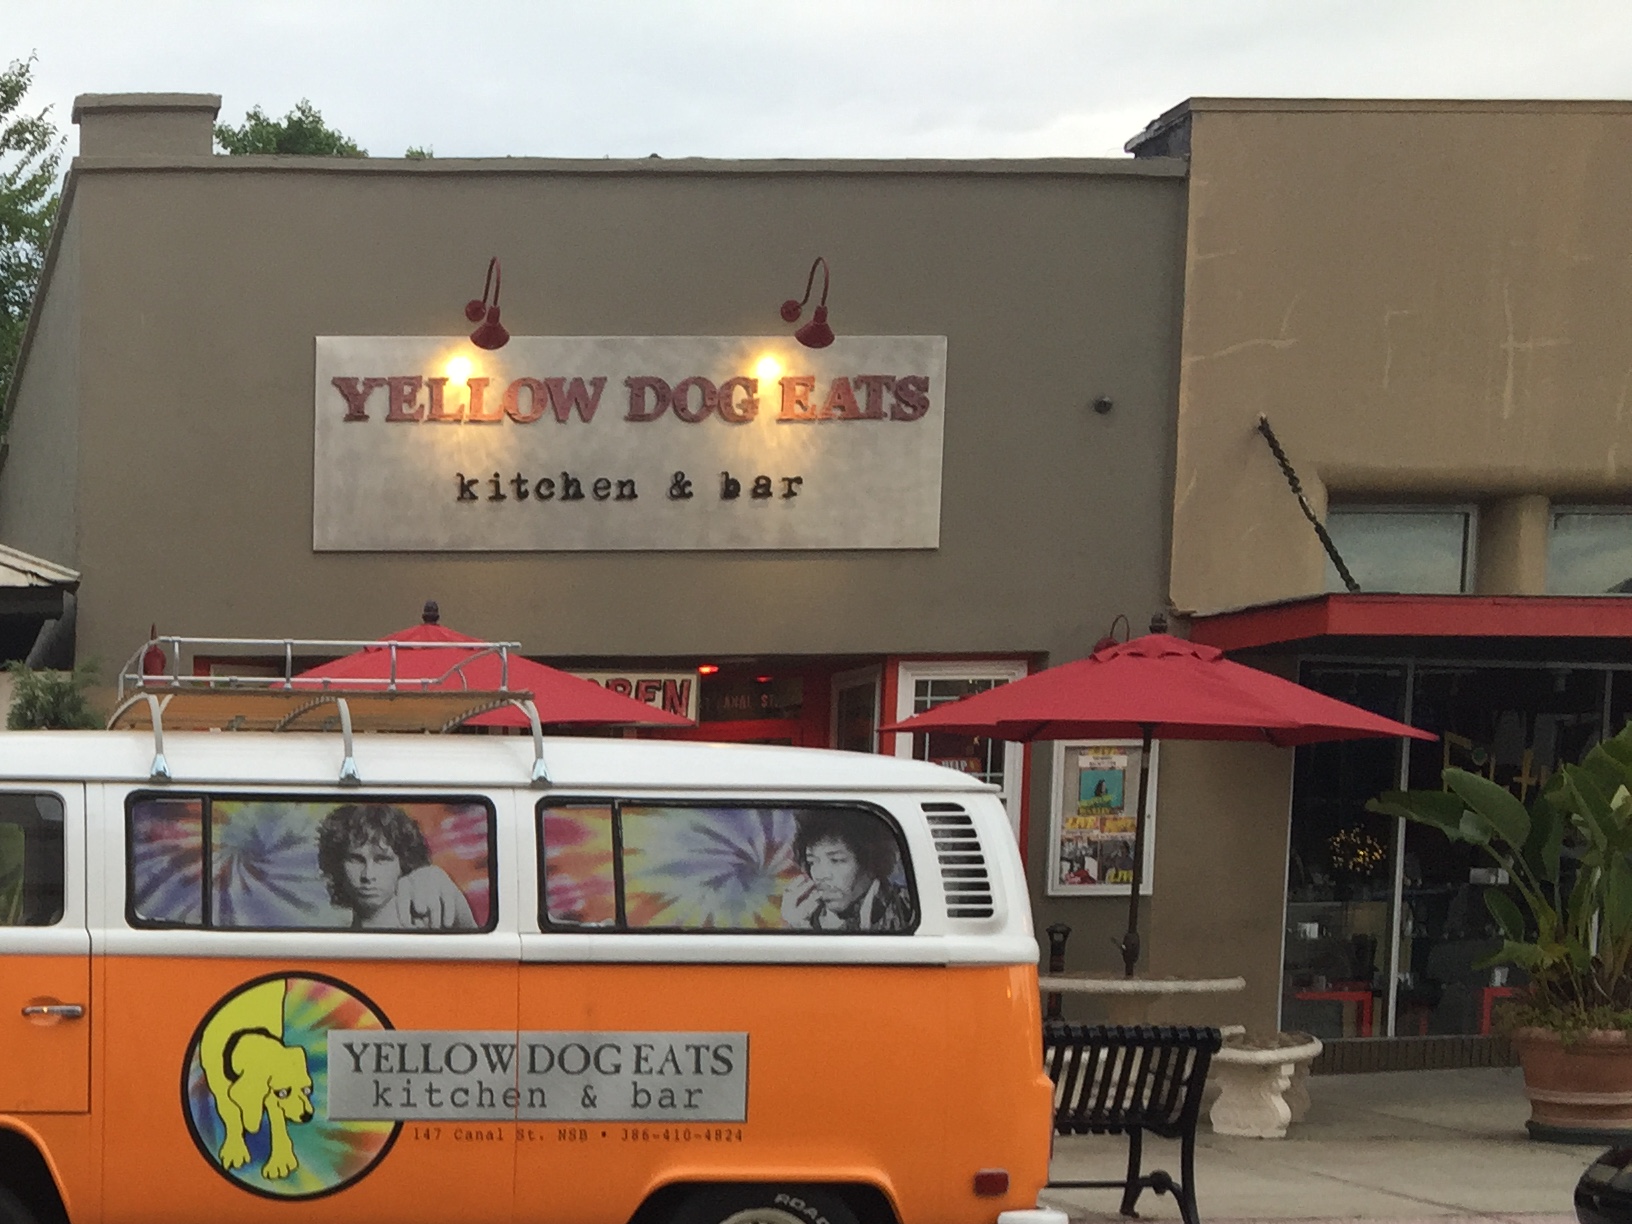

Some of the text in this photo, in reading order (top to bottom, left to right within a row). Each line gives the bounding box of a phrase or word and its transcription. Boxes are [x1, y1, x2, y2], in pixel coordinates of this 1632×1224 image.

[331, 374, 931, 424] YELLOW DOG EATS
[455, 470, 804, 502] kitchen & bar
[587, 677, 692, 719] PEN
[342, 1041, 734, 1076] YELLOW DOG EATS
[372, 1078, 704, 1109] kitchen & bar
[414, 1127, 442, 1141] 147
[454, 1127, 504, 1141] Canal
[516, 1128, 544, 1142] St.
